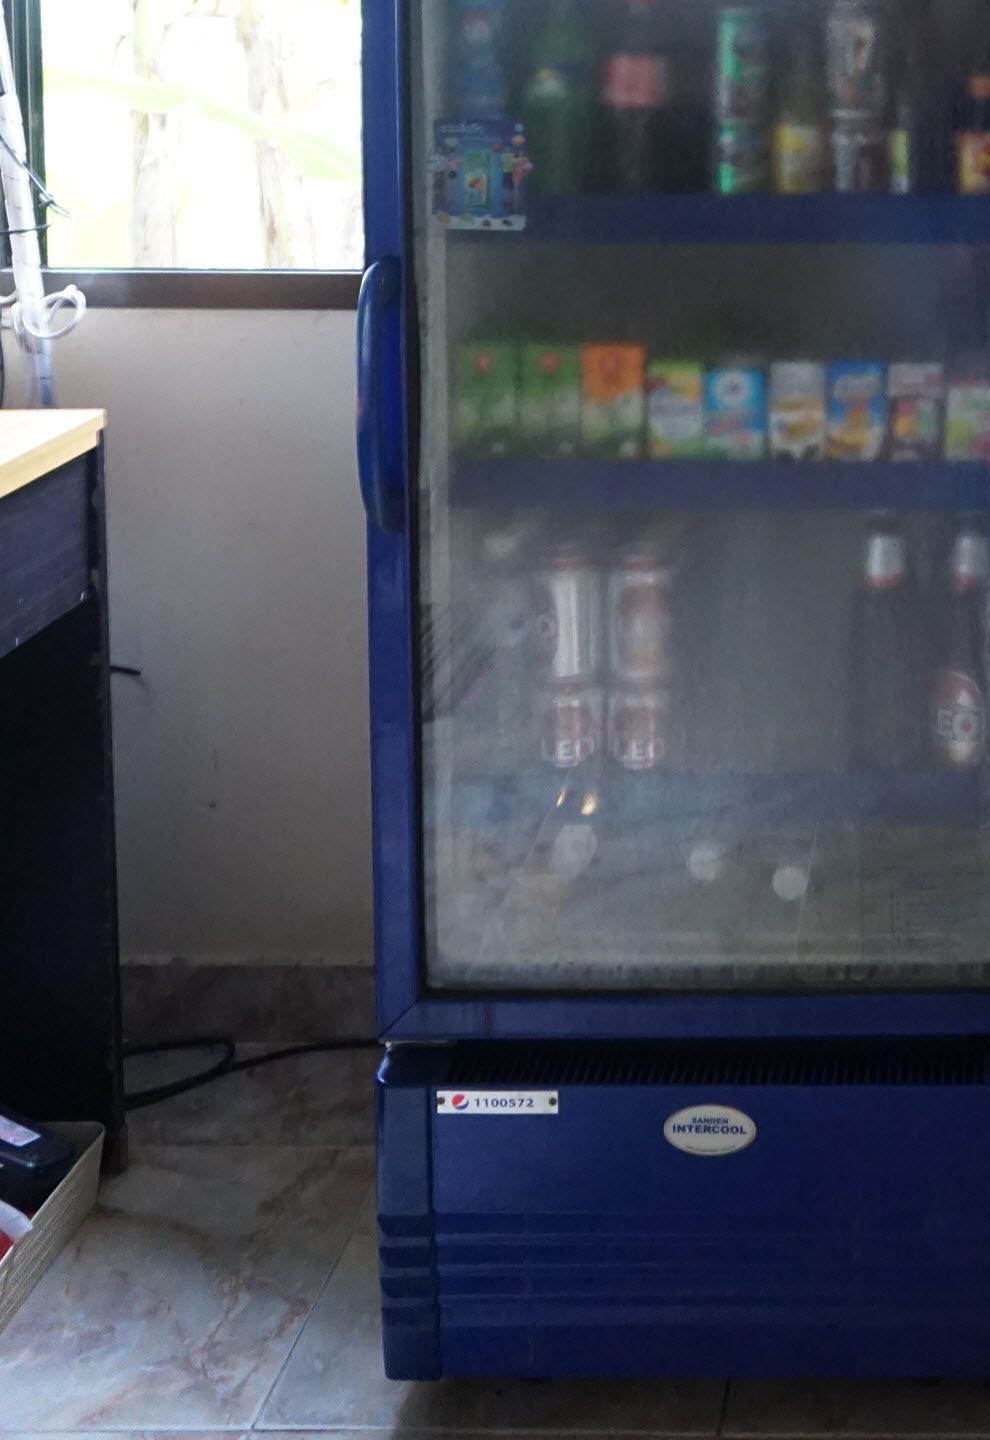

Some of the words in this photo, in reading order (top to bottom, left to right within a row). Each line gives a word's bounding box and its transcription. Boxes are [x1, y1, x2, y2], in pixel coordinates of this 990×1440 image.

[475, 1098, 534, 1108] 1100572
[692, 1117, 729, 1125] SANDEN
[672, 1124, 747, 1135] INTERCOOL
